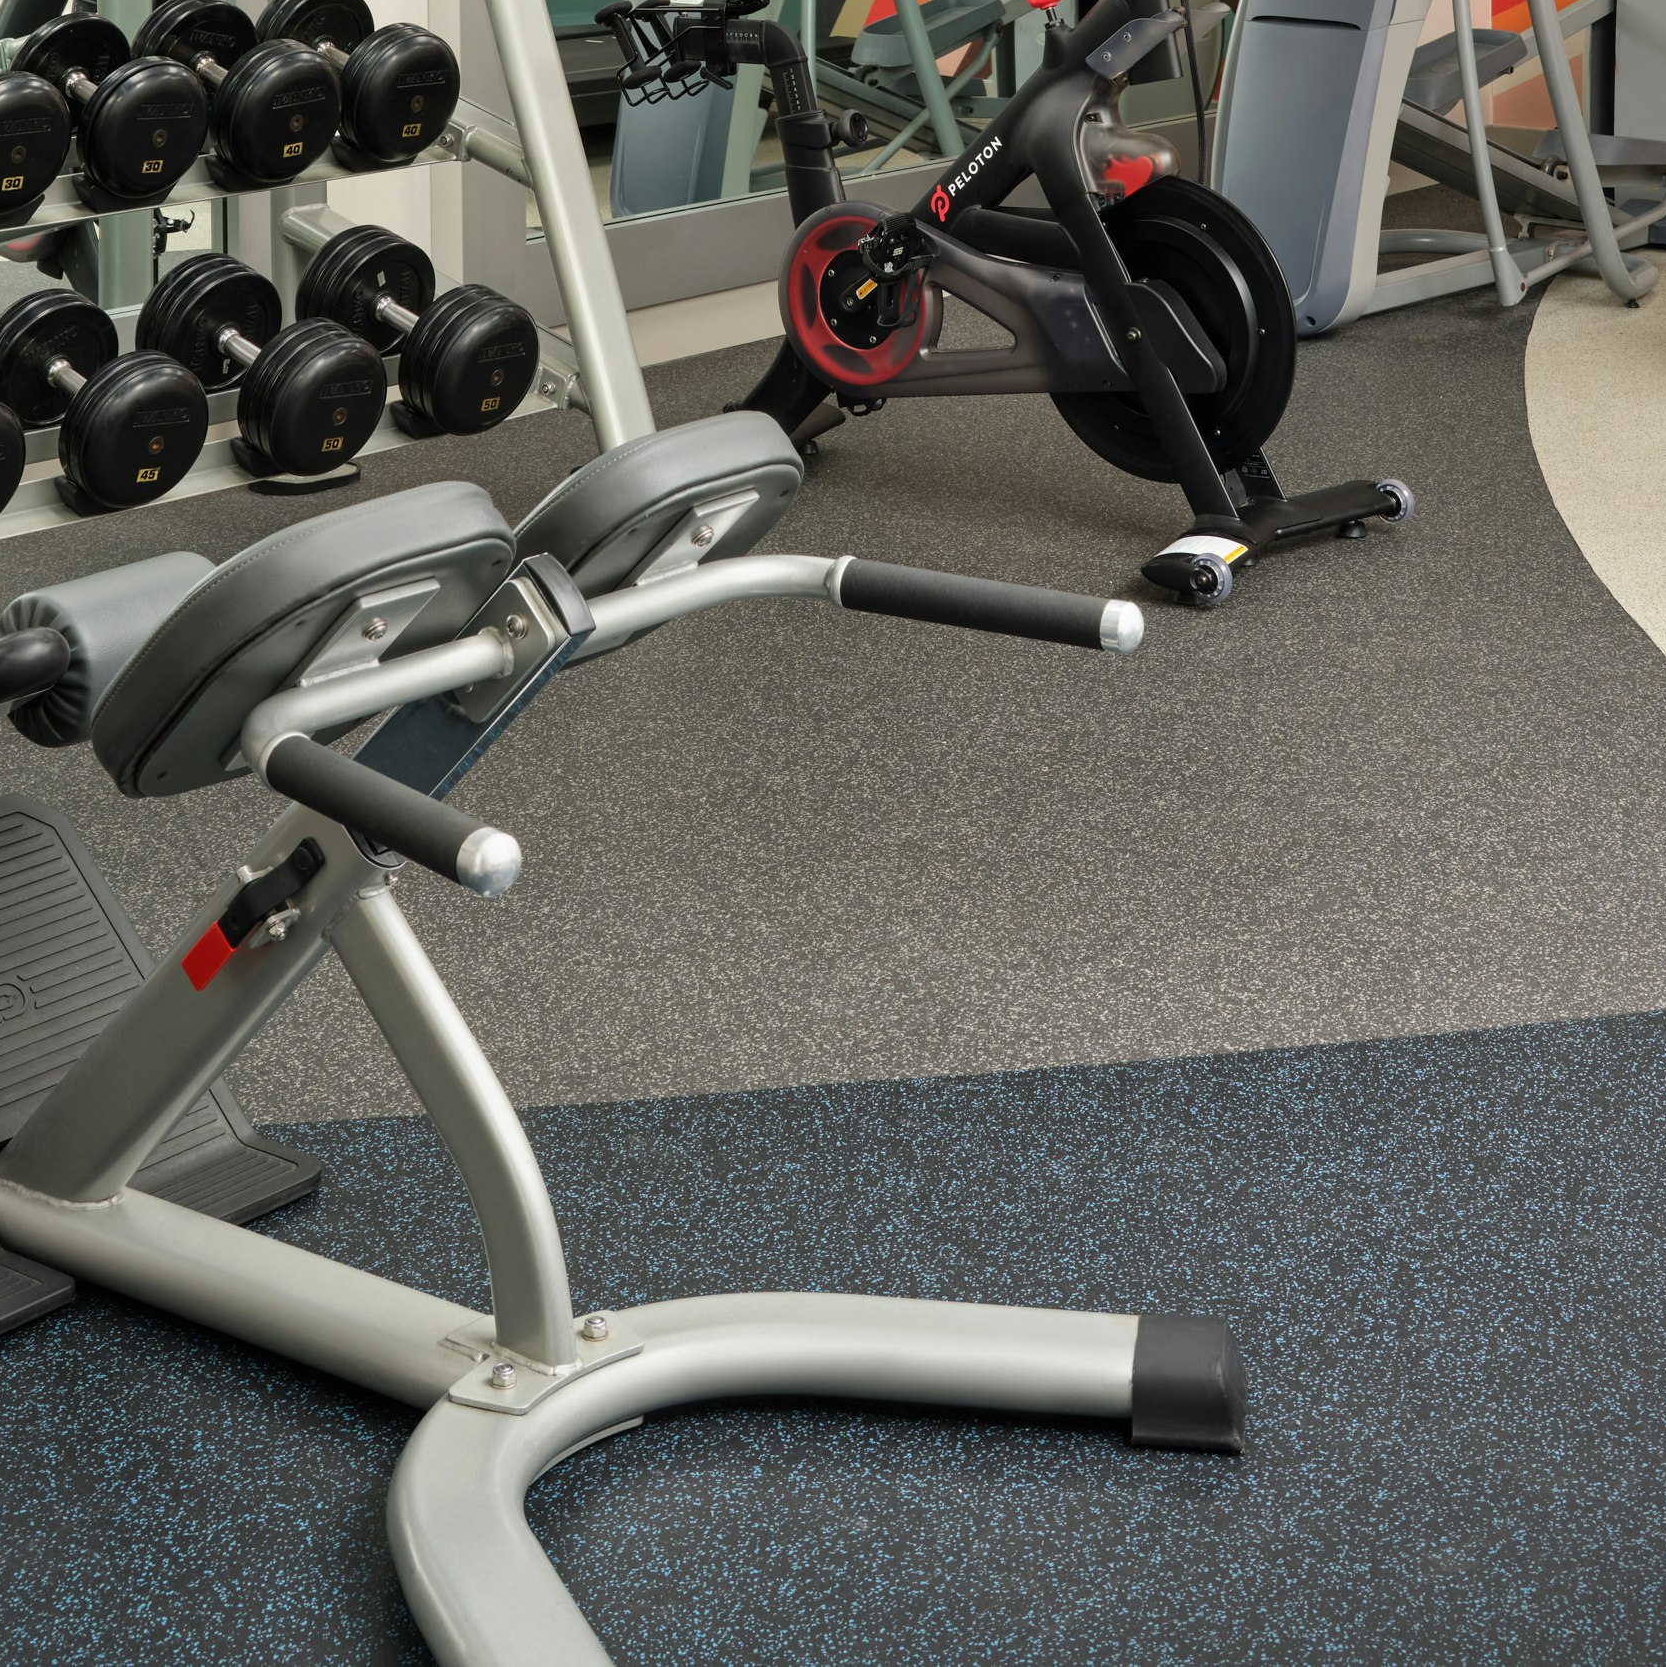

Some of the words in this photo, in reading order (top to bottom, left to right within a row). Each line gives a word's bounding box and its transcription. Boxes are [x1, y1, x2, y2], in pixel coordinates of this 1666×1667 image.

[405, 125, 418, 136] 40
[286, 144, 301, 156] 40
[144, 161, 161, 172] 30
[948, 136, 1002, 196] PELOTON
[4, 177, 21, 189] 30
[484, 399, 498, 410] 50
[325, 439, 341, 450] 50
[139, 470, 156, 482] 45
